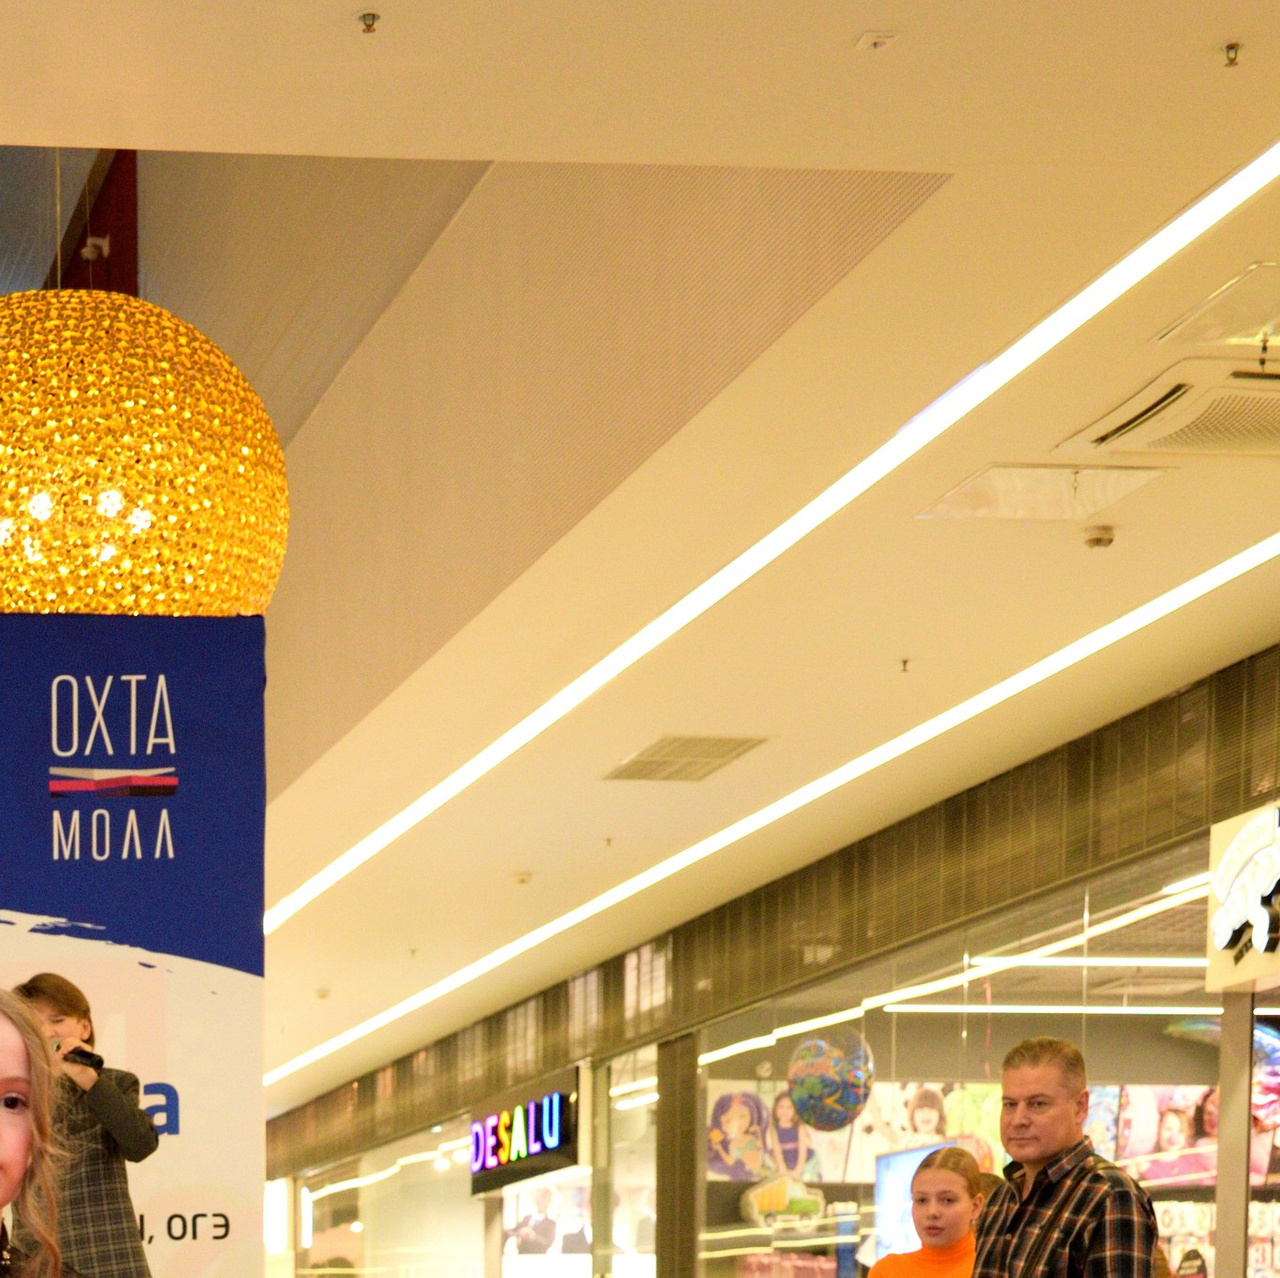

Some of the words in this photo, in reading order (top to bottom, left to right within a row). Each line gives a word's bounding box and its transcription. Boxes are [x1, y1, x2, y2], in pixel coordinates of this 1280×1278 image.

[50, 673, 177, 758] ОХТА
[51, 807, 176, 862] МОЛЛ
[470, 1091, 561, 1174] DESALU
[166, 1213, 231, 1241] ОГЭ
